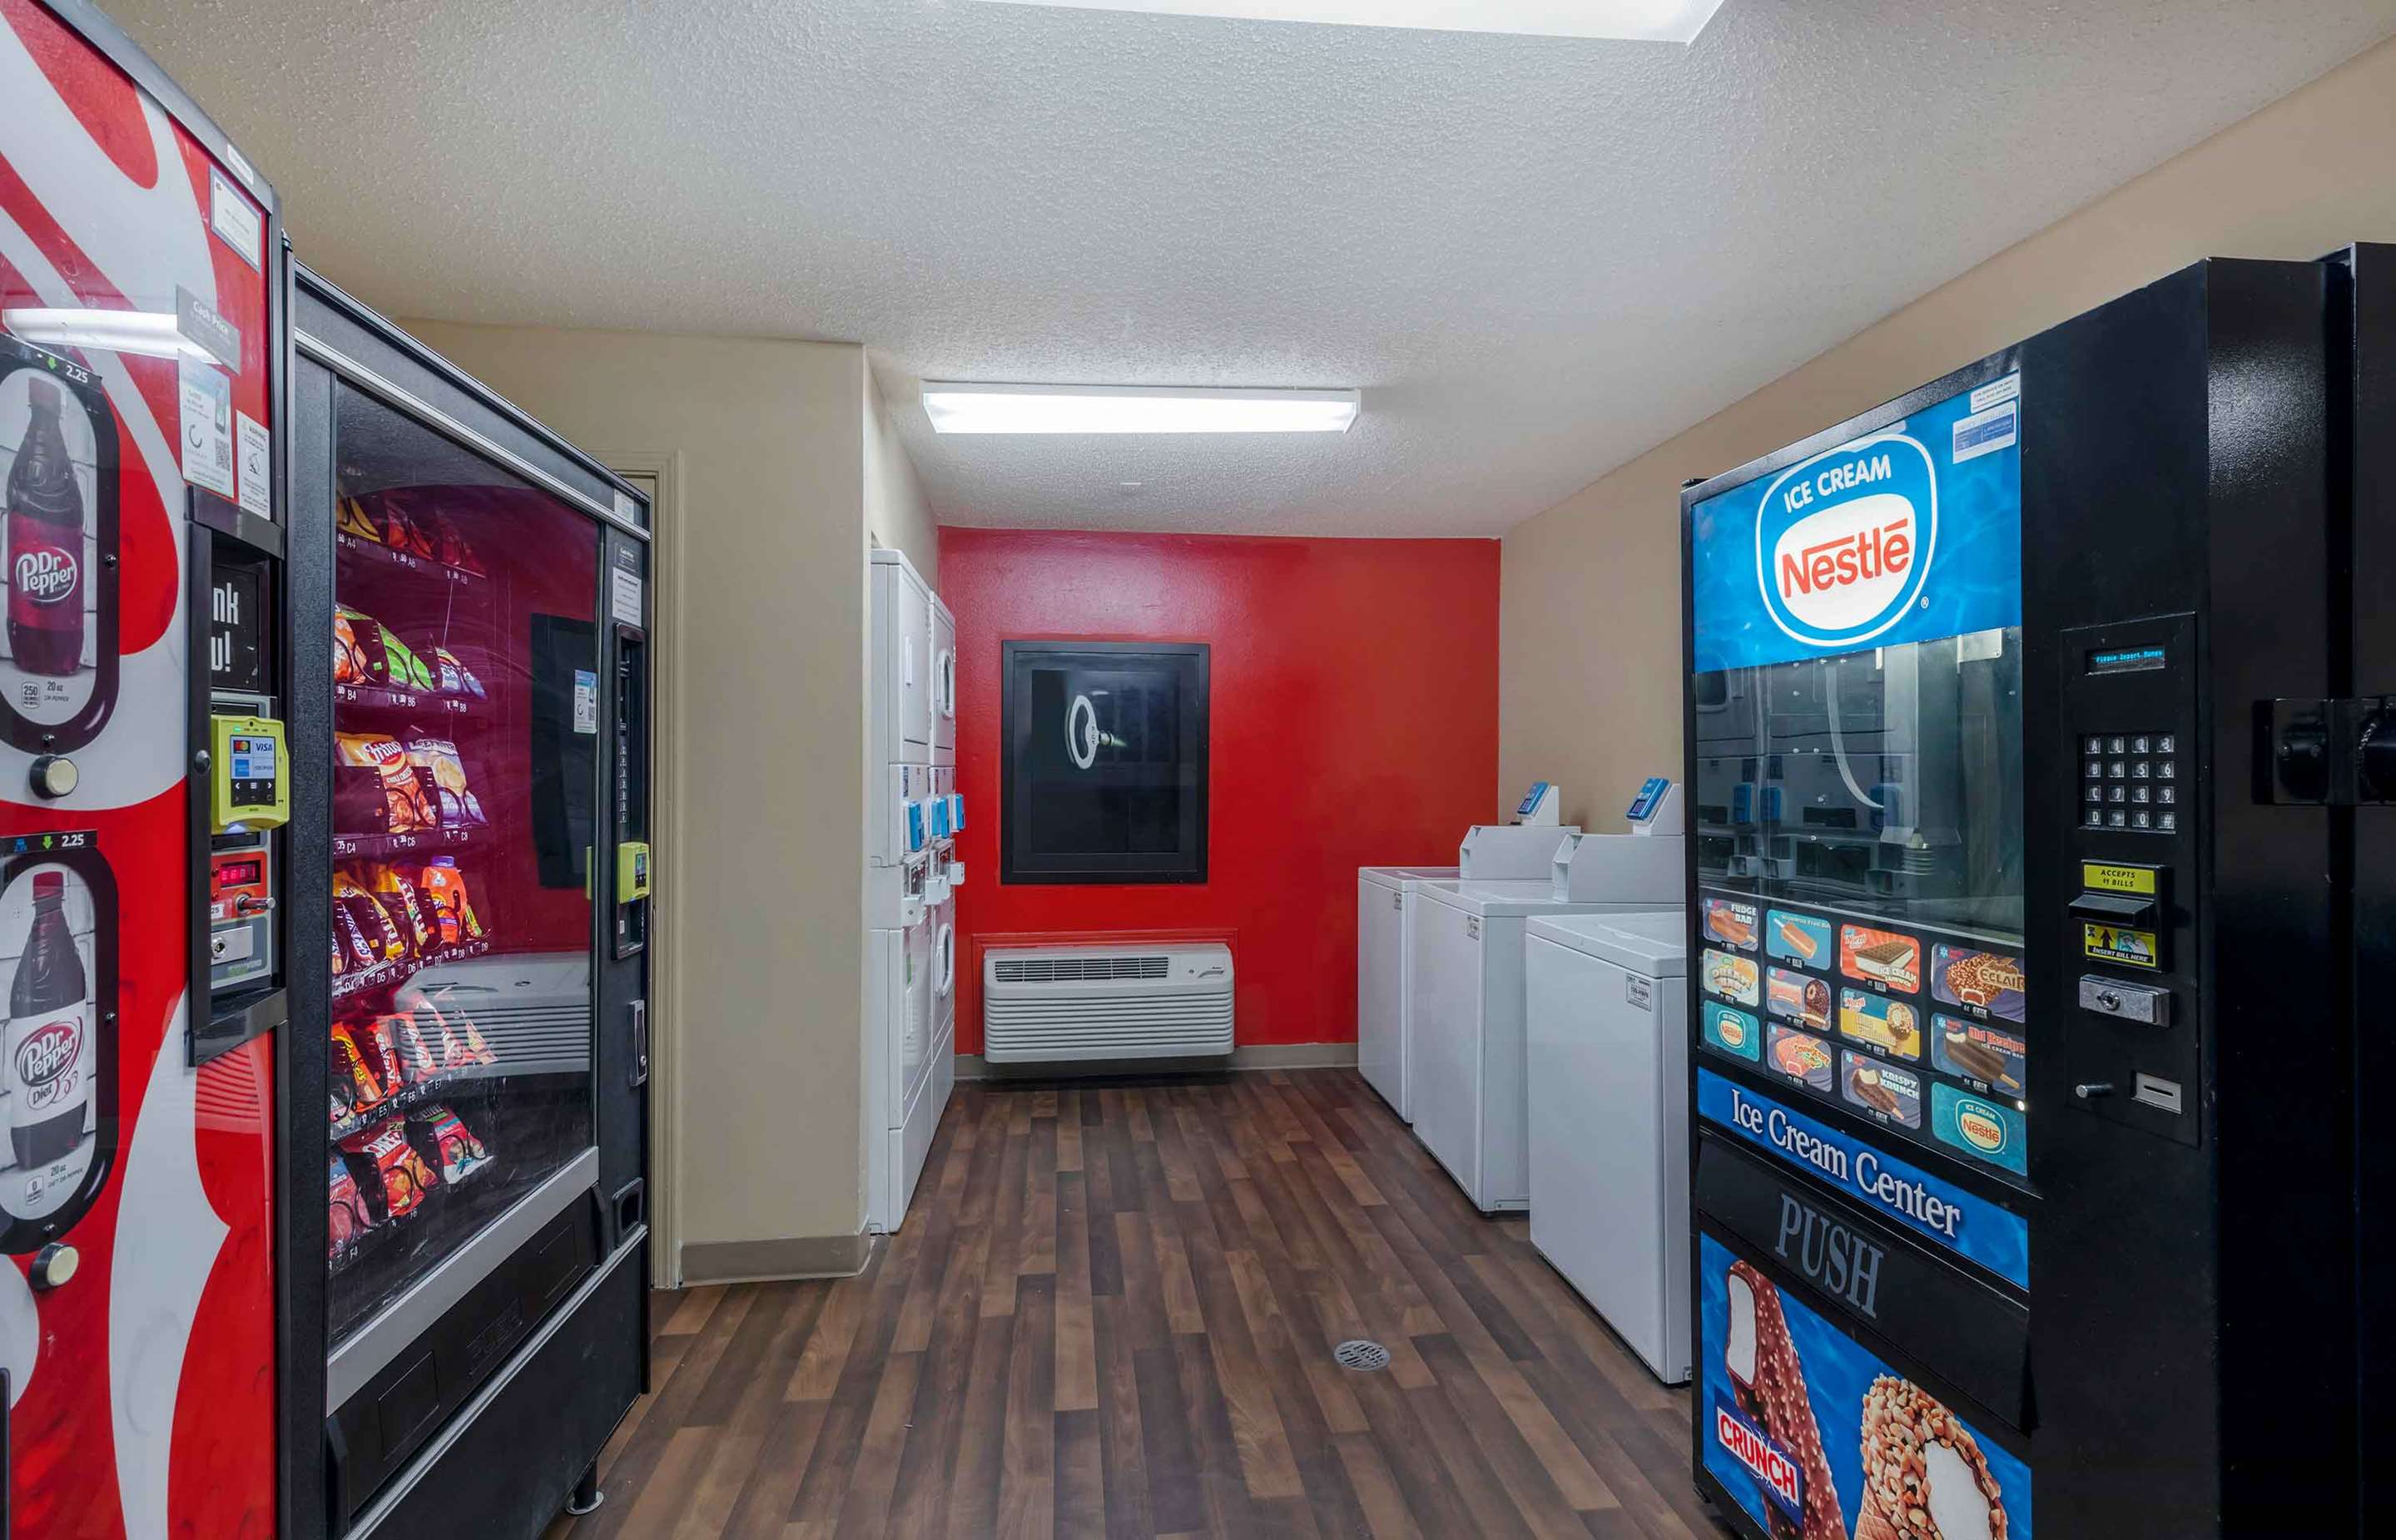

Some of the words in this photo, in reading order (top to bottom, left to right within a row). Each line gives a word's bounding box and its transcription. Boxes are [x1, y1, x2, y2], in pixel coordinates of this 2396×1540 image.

[66, 364, 88, 384] 2.25
[1783, 481, 1814, 513] ICE
[1817, 454, 1892, 497] CREAM
[38, 552, 62, 574] Dr
[1782, 517, 1910, 598] Nestlé
[16, 553, 75, 596] Pepper
[23, 685, 38, 696] 250
[47, 681, 56, 691] 20
[255, 742, 273, 751] VISA
[61, 834, 84, 848] 2.25
[2101, 869, 2136, 879] ACCEPTS
[2111, 879, 2135, 888] BILLS
[1731, 904, 1757, 916] FUDGE
[1735, 914, 1753, 924] BAR
[2093, 947, 2116, 957] INSERT
[2116, 950, 2130, 959] BILL
[2131, 953, 2149, 962] HERE
[1892, 968, 1917, 984] CREAM
[1981, 968, 2025, 988] ECLAIR
[42, 1028, 63, 1051] Dr
[26, 1035, 76, 1082] Pepper
[1880, 1077, 1920, 1100] KRUNCH
[1881, 1070, 1917, 1089] KRISPY
[32, 1083, 53, 1105] Diet
[378, 1106, 388, 1117] E5
[1731, 1088, 1764, 1134] Ice
[1768, 1109, 1849, 1181] Cream
[1856, 1152, 1961, 1239] Center
[1775, 1193, 1884, 1320] PUSH
[1719, 1412, 1797, 1501] CRUNCH
